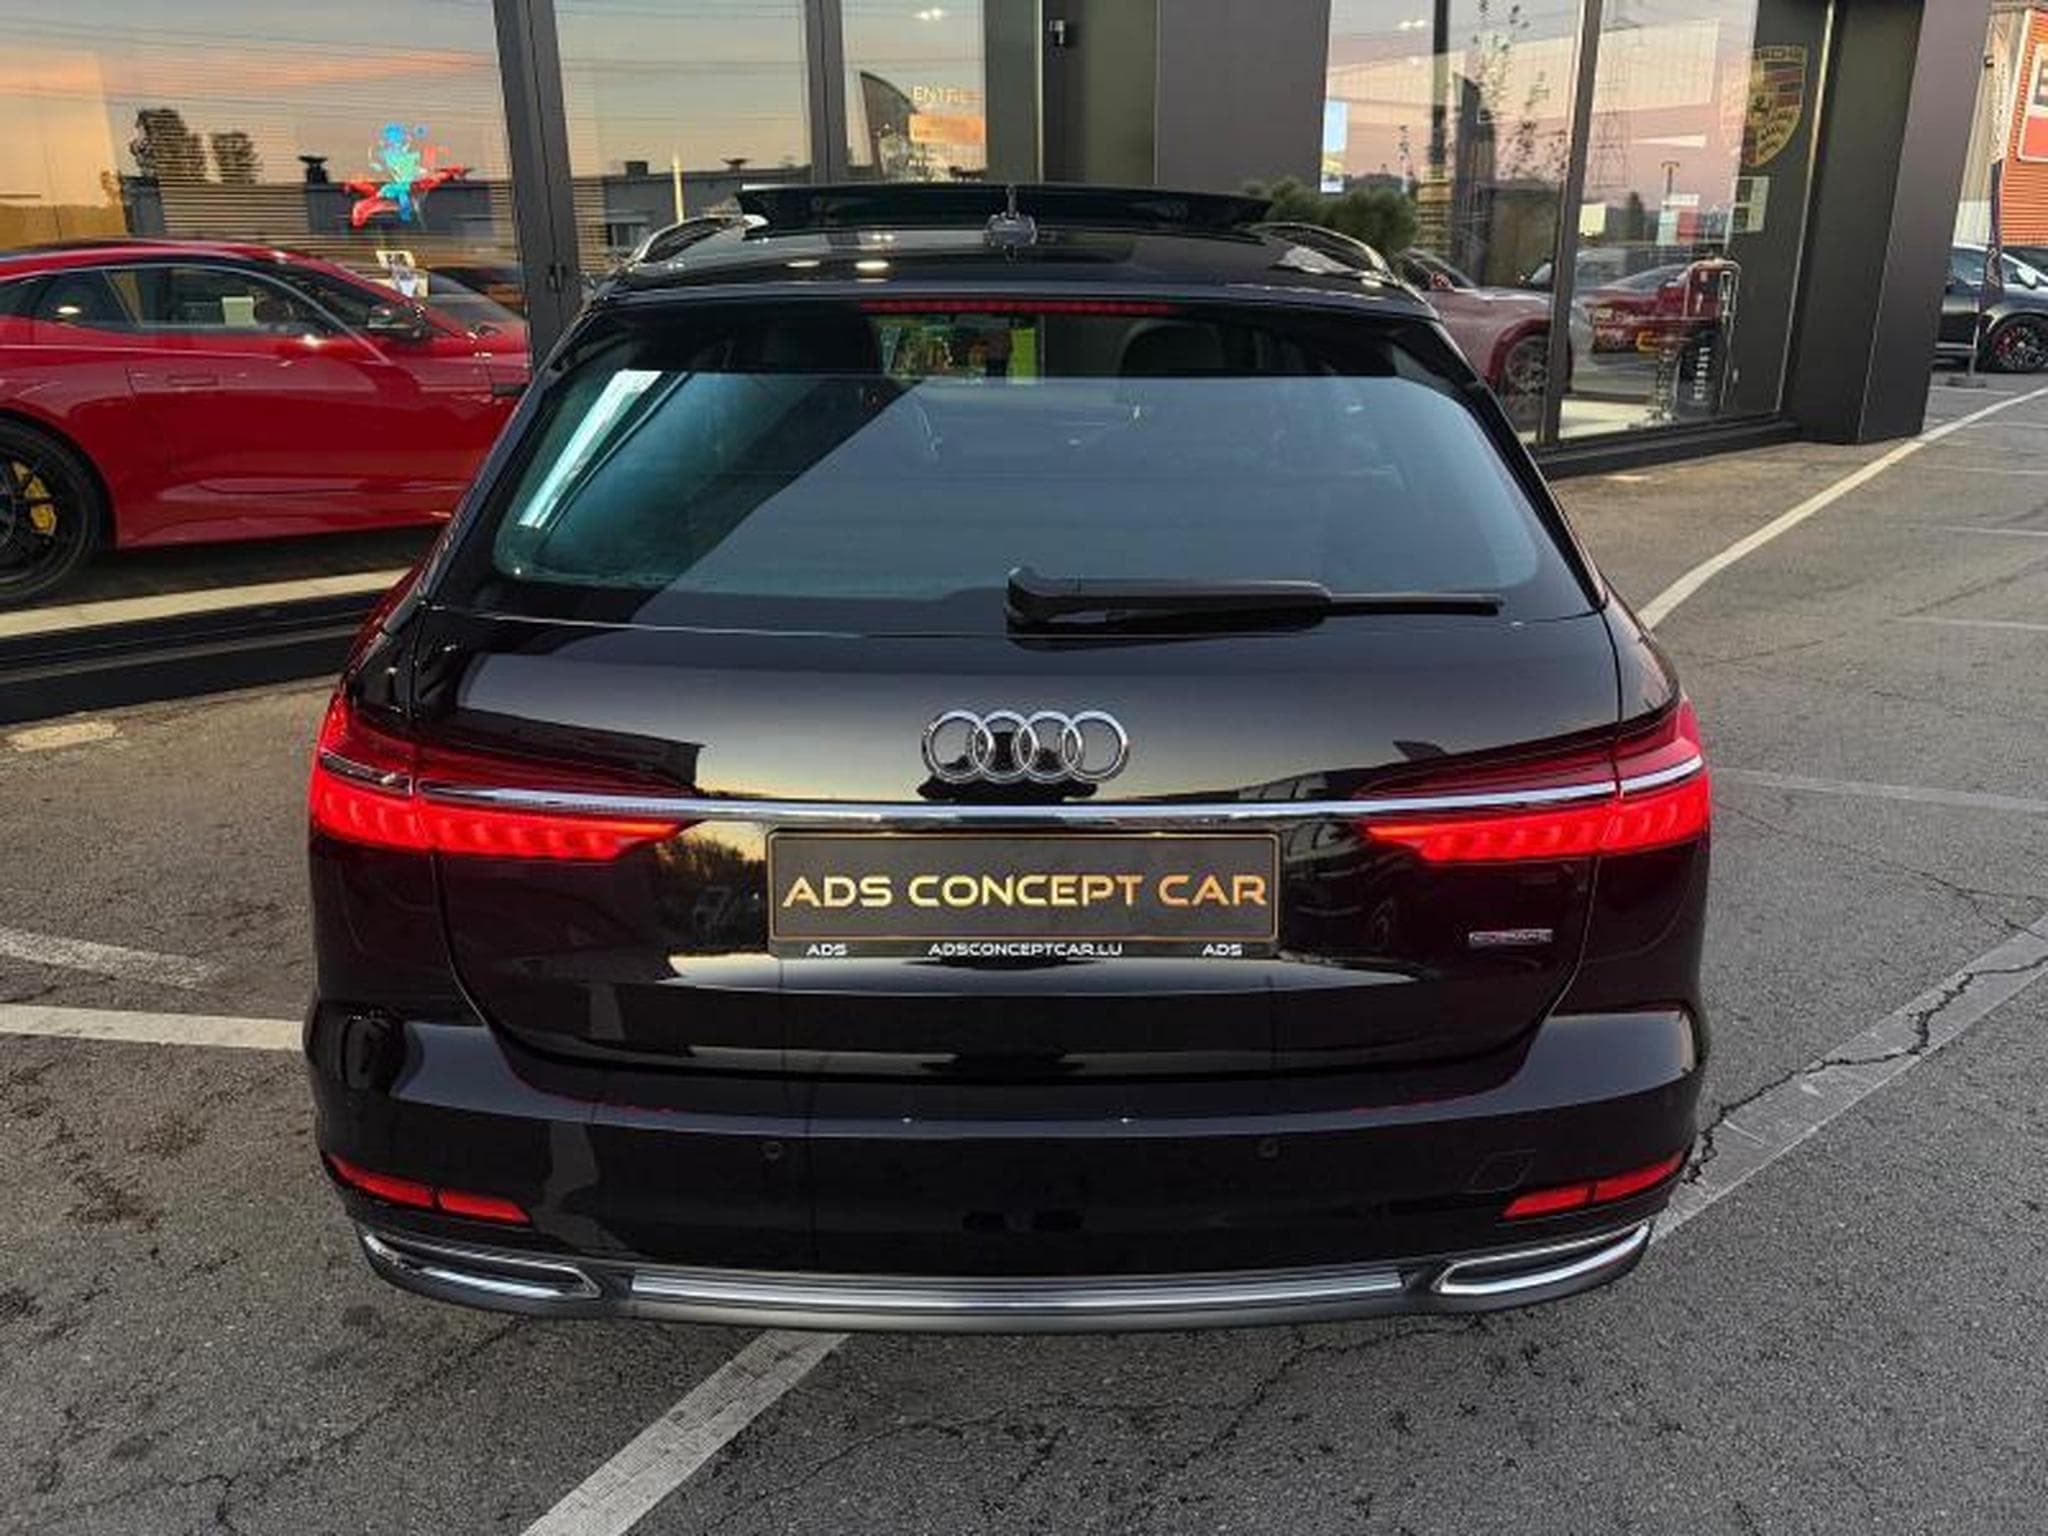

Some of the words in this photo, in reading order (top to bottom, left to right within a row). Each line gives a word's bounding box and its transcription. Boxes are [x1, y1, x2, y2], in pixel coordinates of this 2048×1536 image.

[782, 874, 893, 907] ADS
[908, 874, 1144, 907] CONCEPT
[1158, 874, 1268, 907] CAR
[806, 942, 848, 957] ADS
[928, 942, 1123, 957] ADSCONCEPTCAR.LU
[1202, 942, 1243, 957] ADS
